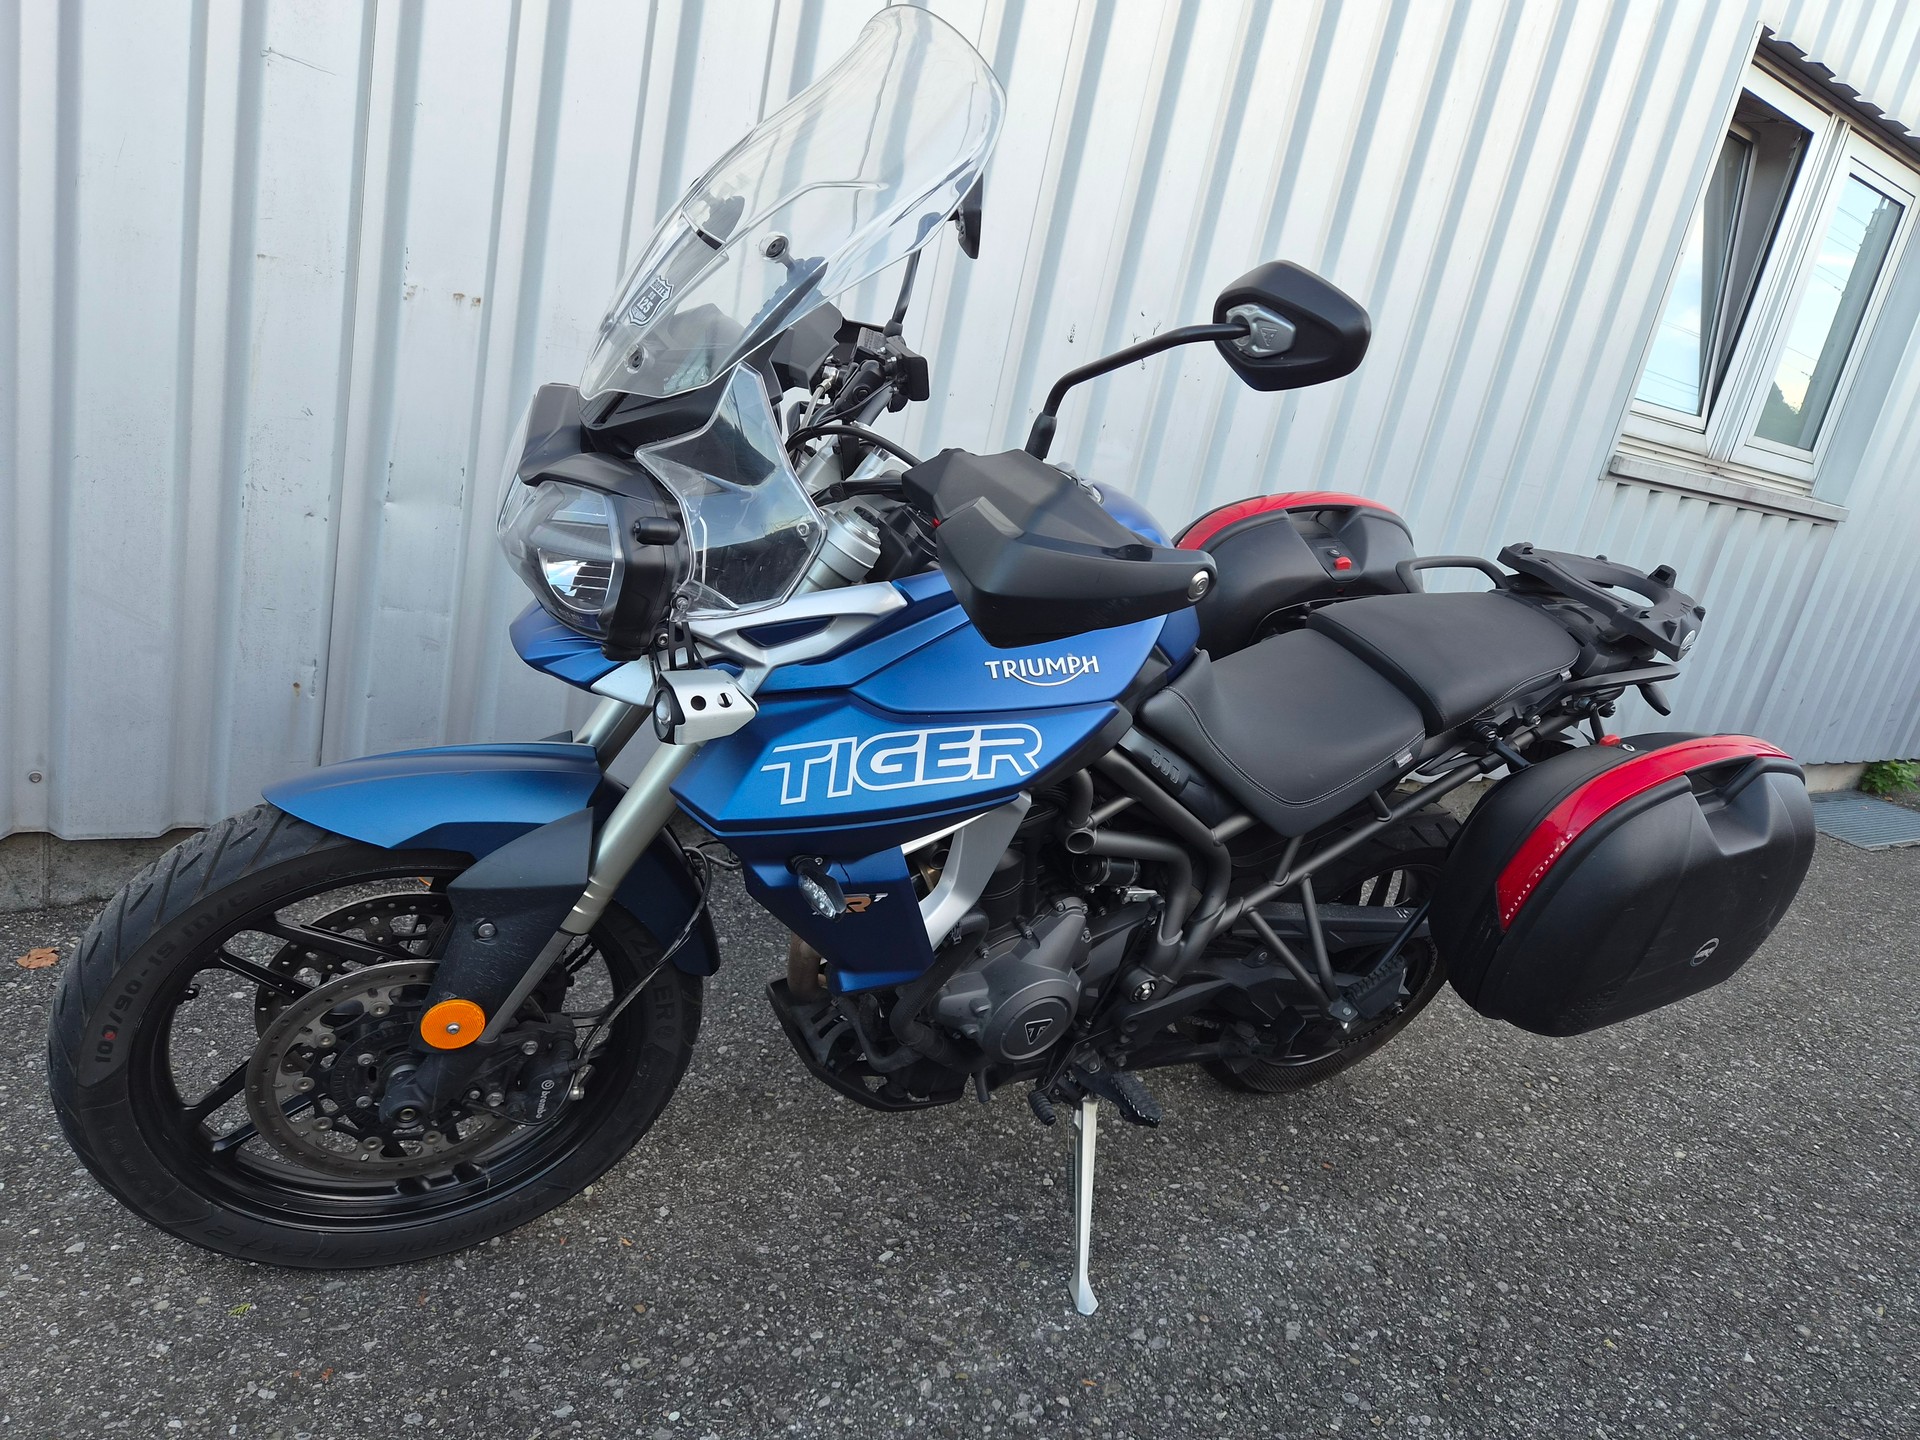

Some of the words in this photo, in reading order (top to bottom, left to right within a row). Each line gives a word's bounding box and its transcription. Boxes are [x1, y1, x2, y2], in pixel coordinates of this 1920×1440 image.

[637, 296, 654, 313] 125
[984, 655, 1100, 687] TRIUMPH
[760, 723, 1043, 806] TIGER
[535, 1090, 551, 1119] brembo
